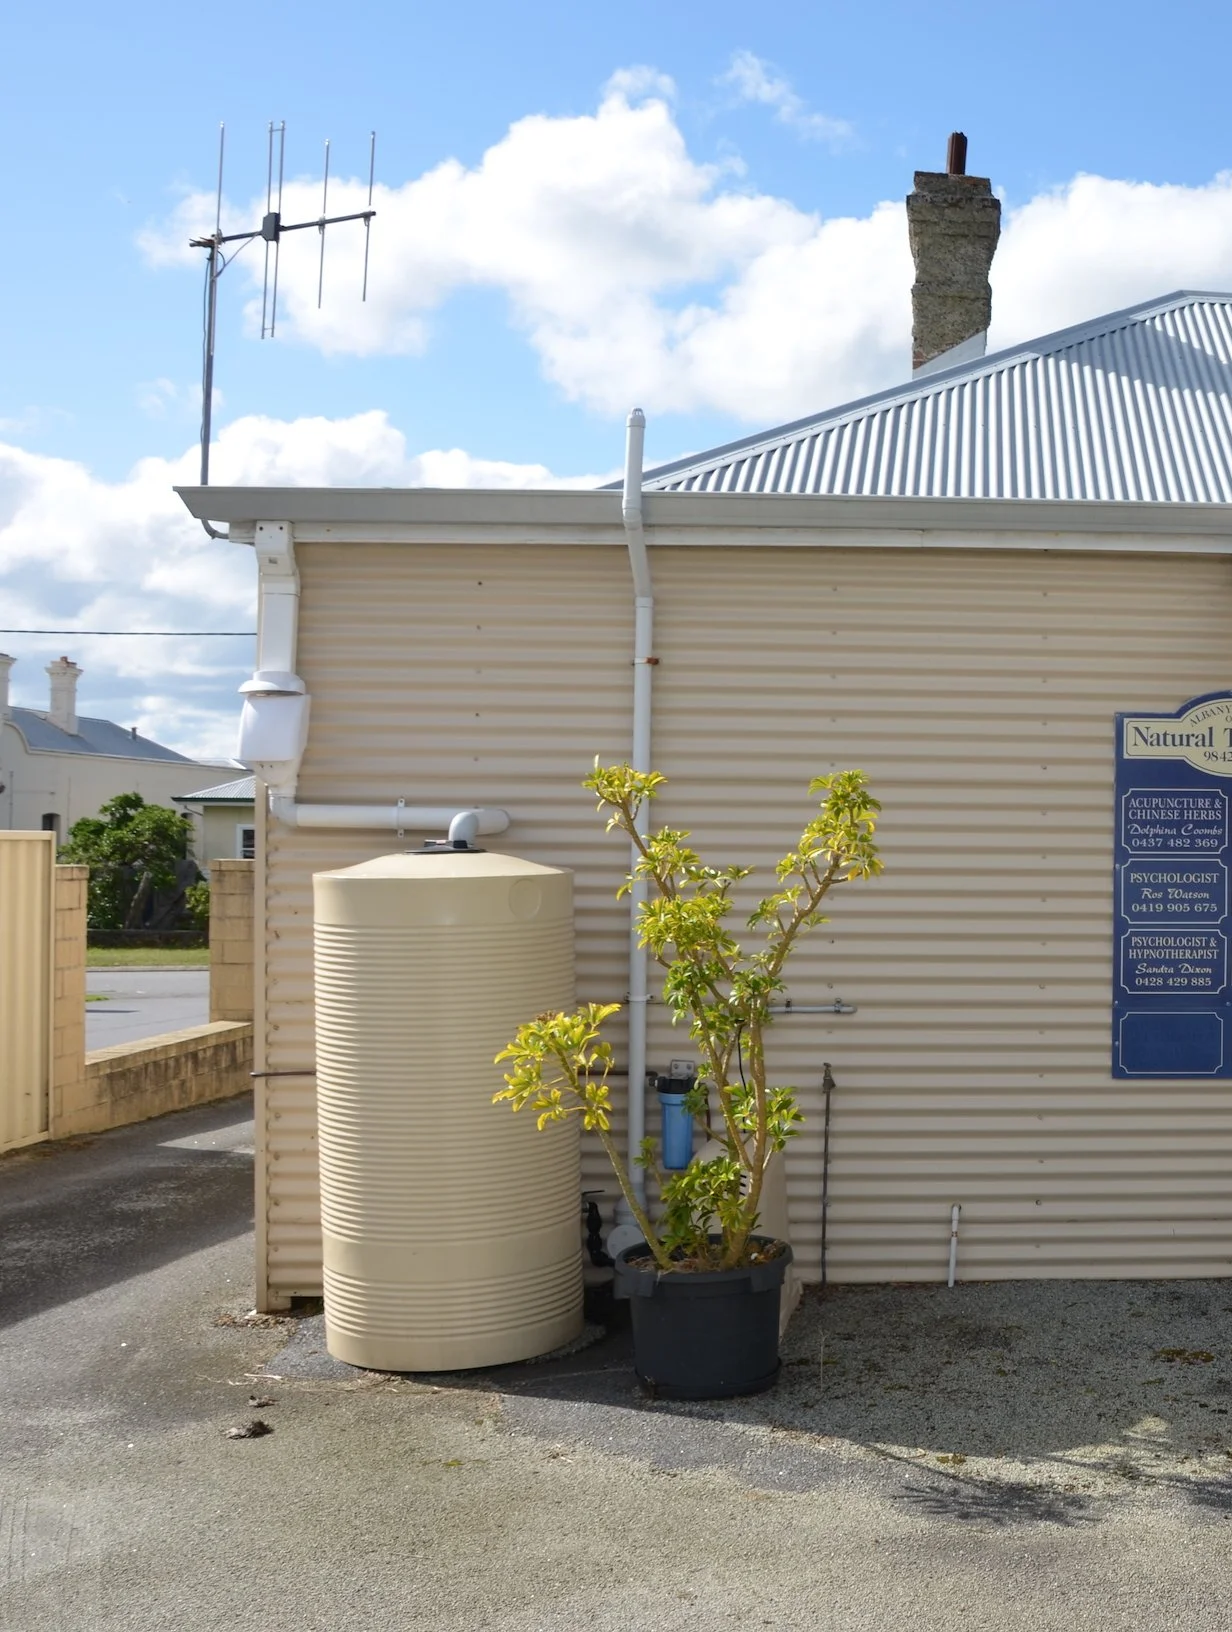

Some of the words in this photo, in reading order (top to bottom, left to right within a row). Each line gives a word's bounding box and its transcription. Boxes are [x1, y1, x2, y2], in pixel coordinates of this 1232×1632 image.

[1190, 704, 1232, 727] ALBANY
[1133, 726, 1214, 747] Natural
[1129, 798, 1211, 809] ACUPUNCTURE
[1214, 799, 1222, 808] &
[1128, 810, 1180, 820] CHINESE
[1184, 811, 1222, 820] HERBS
[1181, 824, 1222, 835] Coombs
[1132, 839, 1162, 847] 0437
[1168, 839, 1190, 847] 482
[1195, 839, 1218, 847] 369
[1130, 873, 1219, 884] PSYCHOLOGIST
[1141, 888, 1163, 899] Ros
[1168, 889, 1209, 899] Watson
[1132, 904, 1163, 912] 0419
[1168, 904, 1190, 912] 905
[1194, 904, 1217, 912] 675
[1132, 937, 1207, 947] PSYCHOLOGIST
[1209, 938, 1216, 946] &
[1129, 949, 1219, 959] HYPNOTHERAPIST
[1136, 963, 1174, 974] Sandra
[1179, 964, 1212, 974] Dixon
[1135, 978, 1163, 986] 0428
[1167, 978, 1188, 986] 429
[1191, 978, 1212, 986] 885
